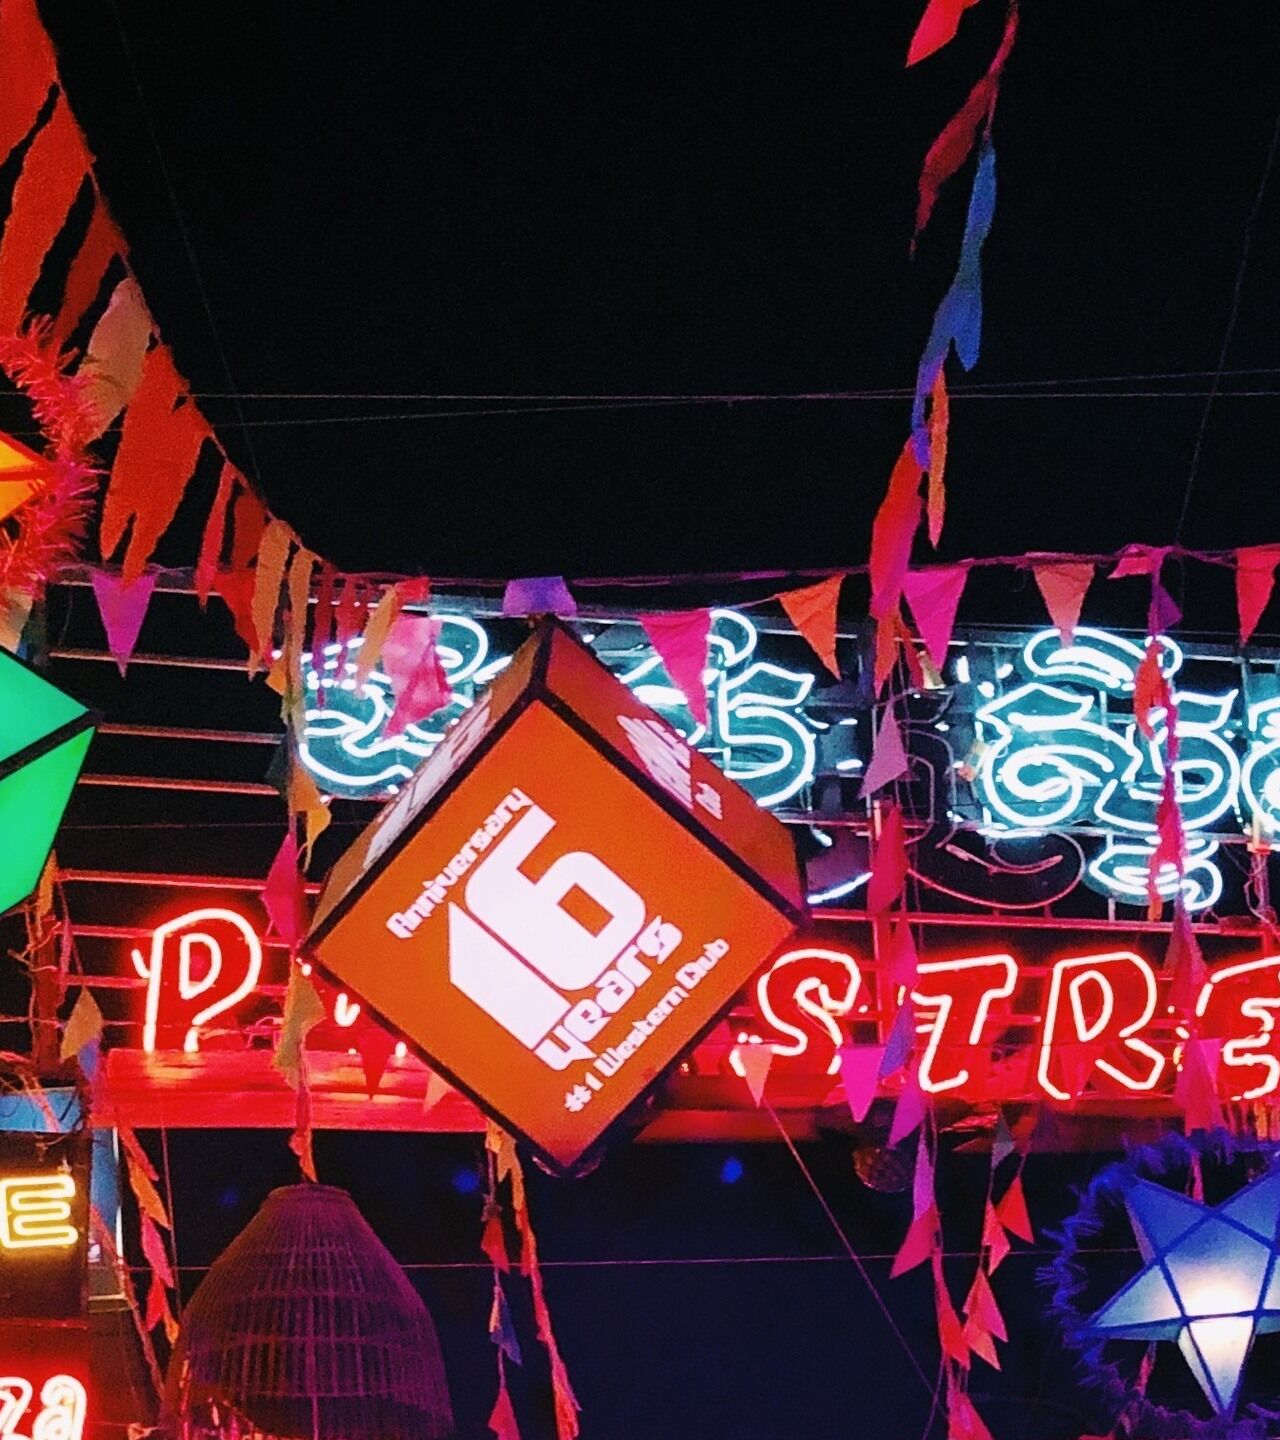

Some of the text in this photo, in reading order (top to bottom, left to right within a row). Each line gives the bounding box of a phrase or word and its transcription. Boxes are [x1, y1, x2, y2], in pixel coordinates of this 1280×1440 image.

[386, 787, 534, 939] Anniversary
[448, 804, 647, 1051] 16
[533, 915, 683, 1071] years
[675, 938, 730, 990] Club
